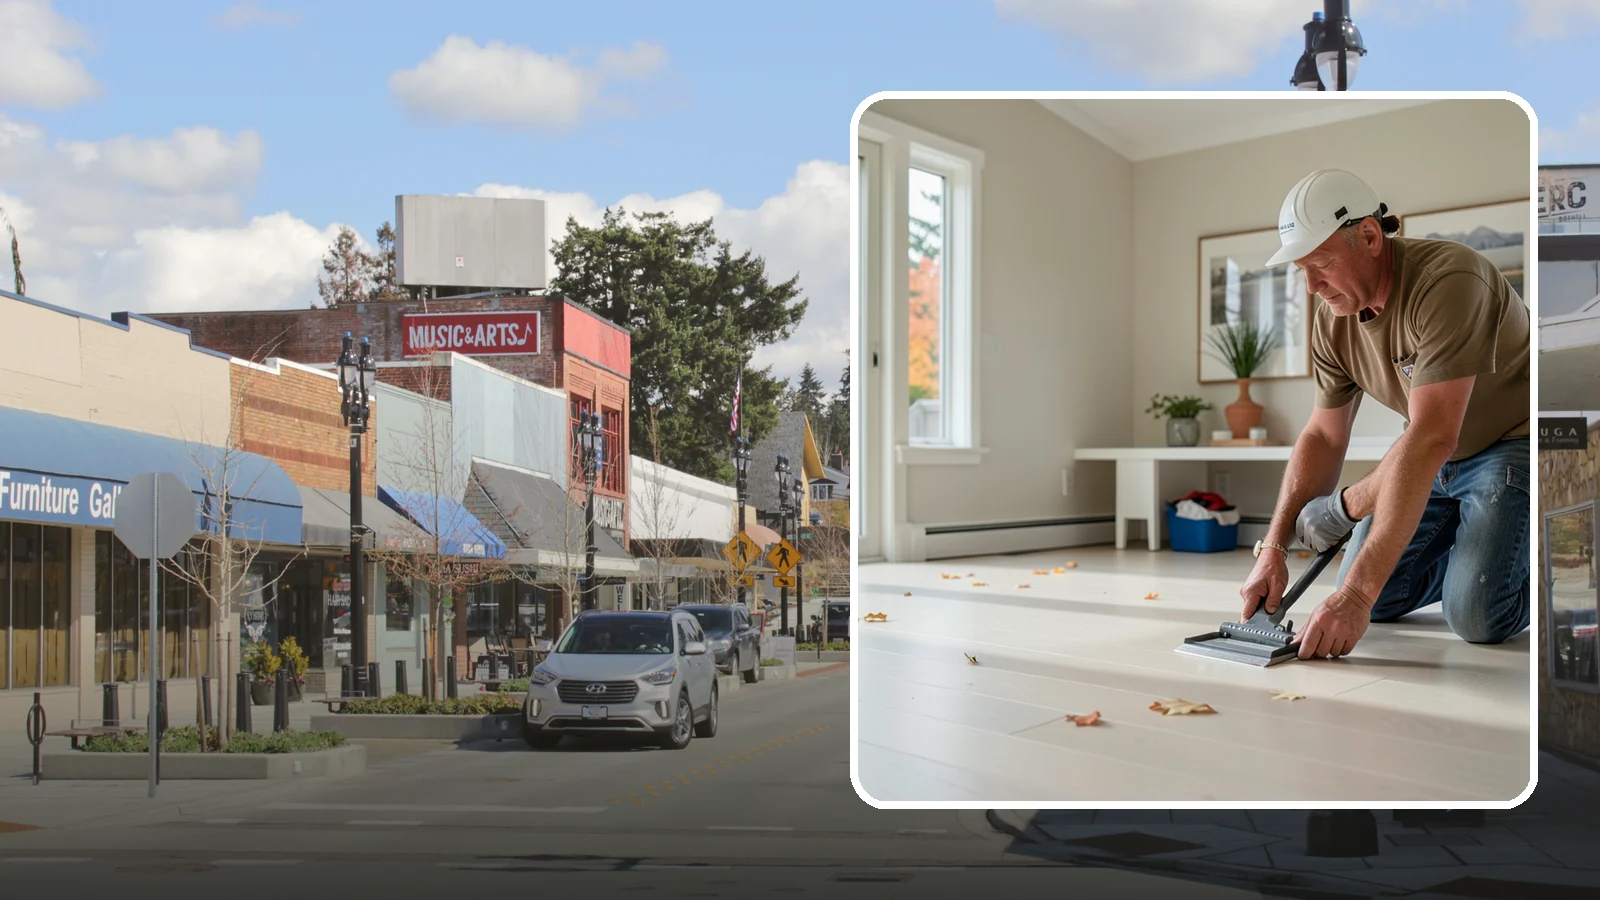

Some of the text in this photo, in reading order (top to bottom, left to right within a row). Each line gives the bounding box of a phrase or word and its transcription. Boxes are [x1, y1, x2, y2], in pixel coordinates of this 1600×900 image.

[408, 323, 520, 349] MUSIC&ARTS
[0, 471, 121, 519] Furniture Gal
[453, 563, 478, 574] SUSHI
